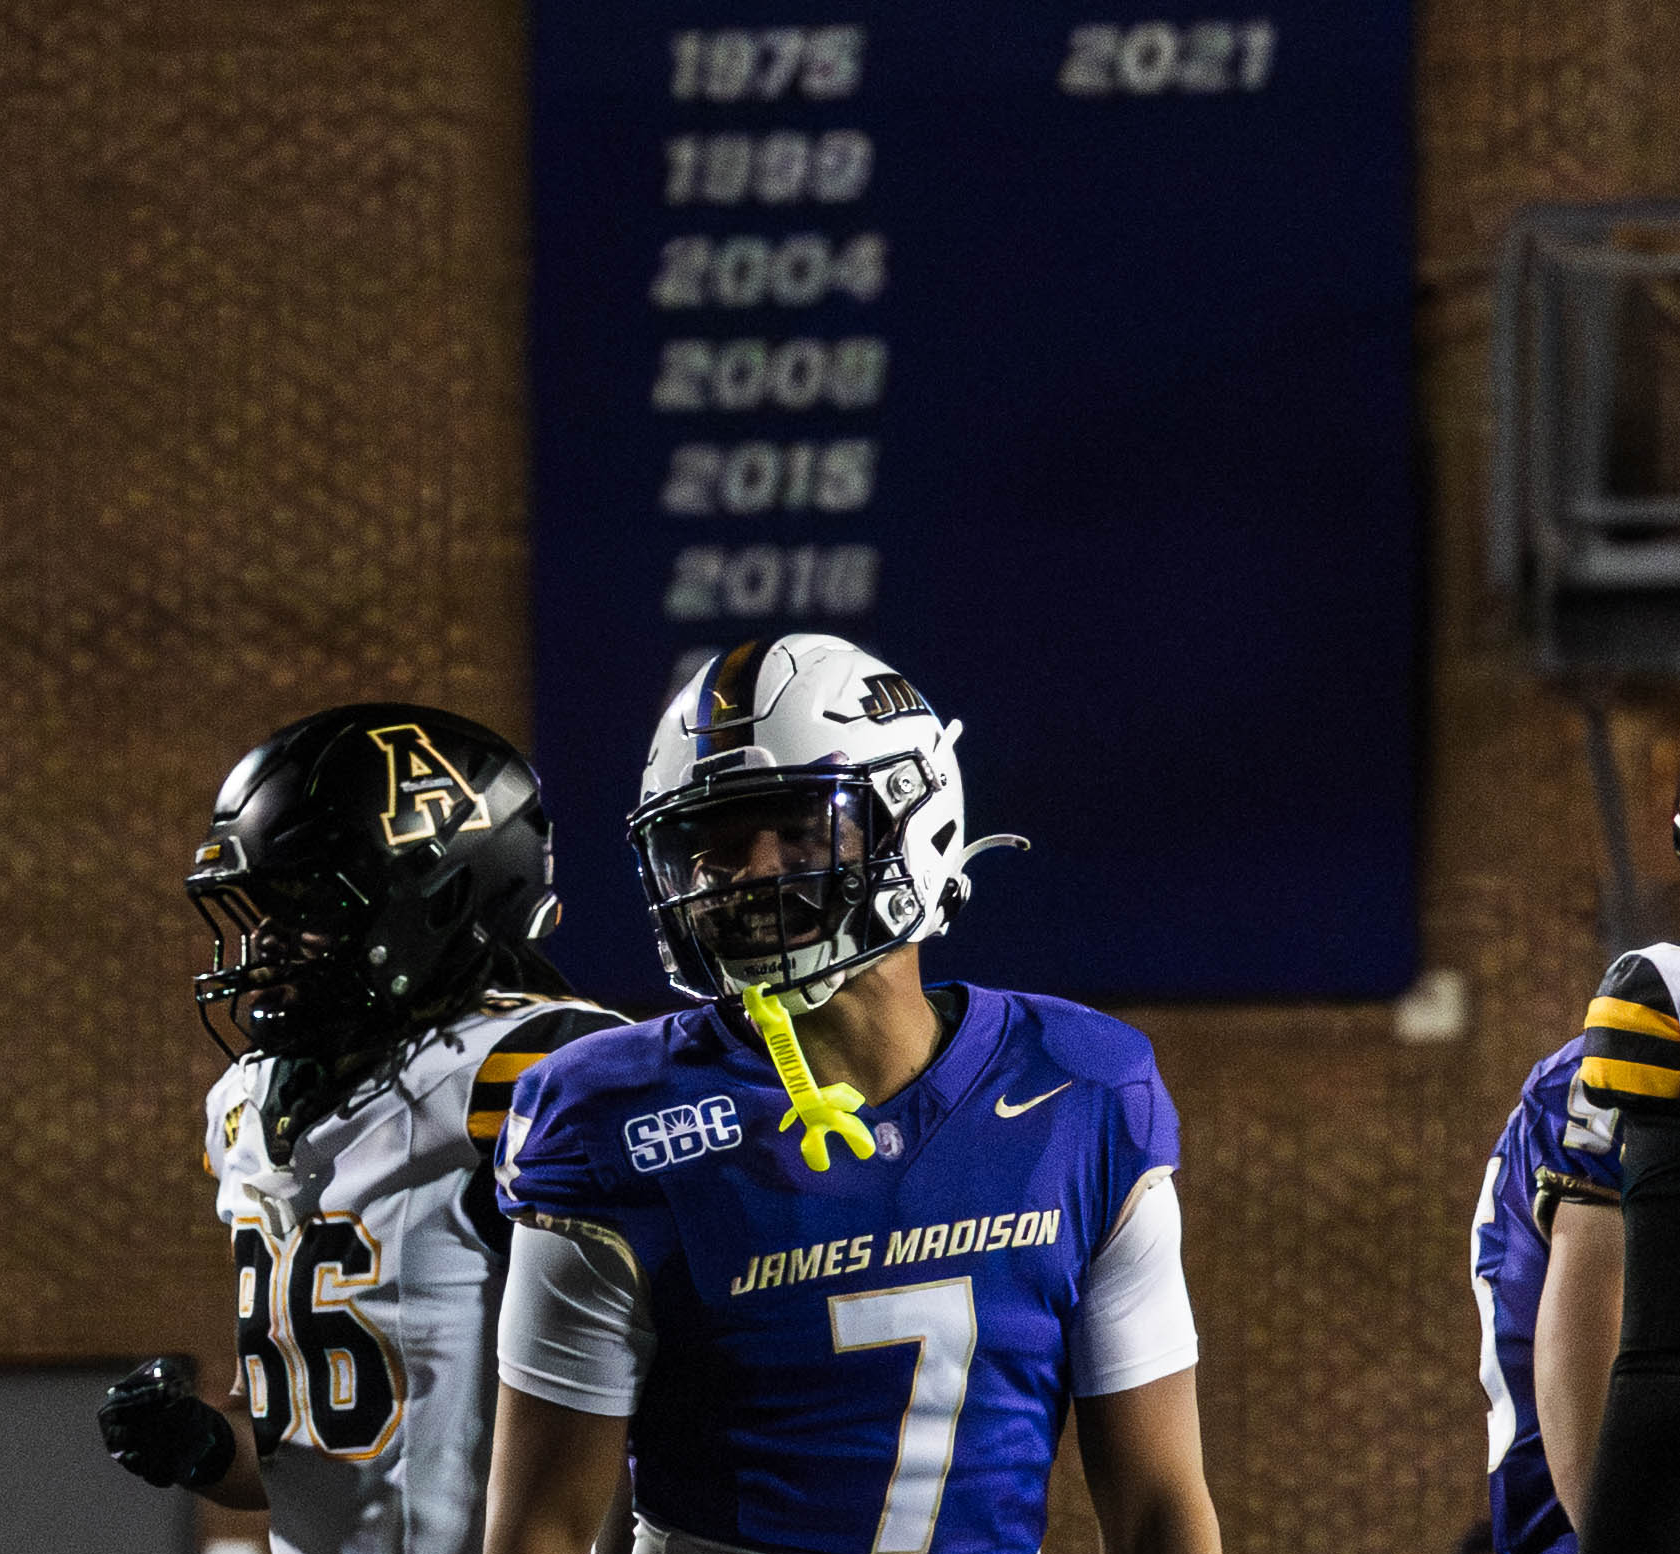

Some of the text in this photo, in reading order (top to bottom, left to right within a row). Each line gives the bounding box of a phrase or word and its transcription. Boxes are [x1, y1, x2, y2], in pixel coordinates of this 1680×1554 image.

[669, 27, 865, 99] 1975
[1059, 21, 1277, 96] 2021
[652, 234, 887, 307] 2004
[662, 441, 878, 513] 2015
[367, 723, 492, 847] A
[769, 1032, 810, 1095] NXTRND
[624, 1095, 742, 1173] SBC
[731, 1209, 1061, 1296] JAMES MADISON
